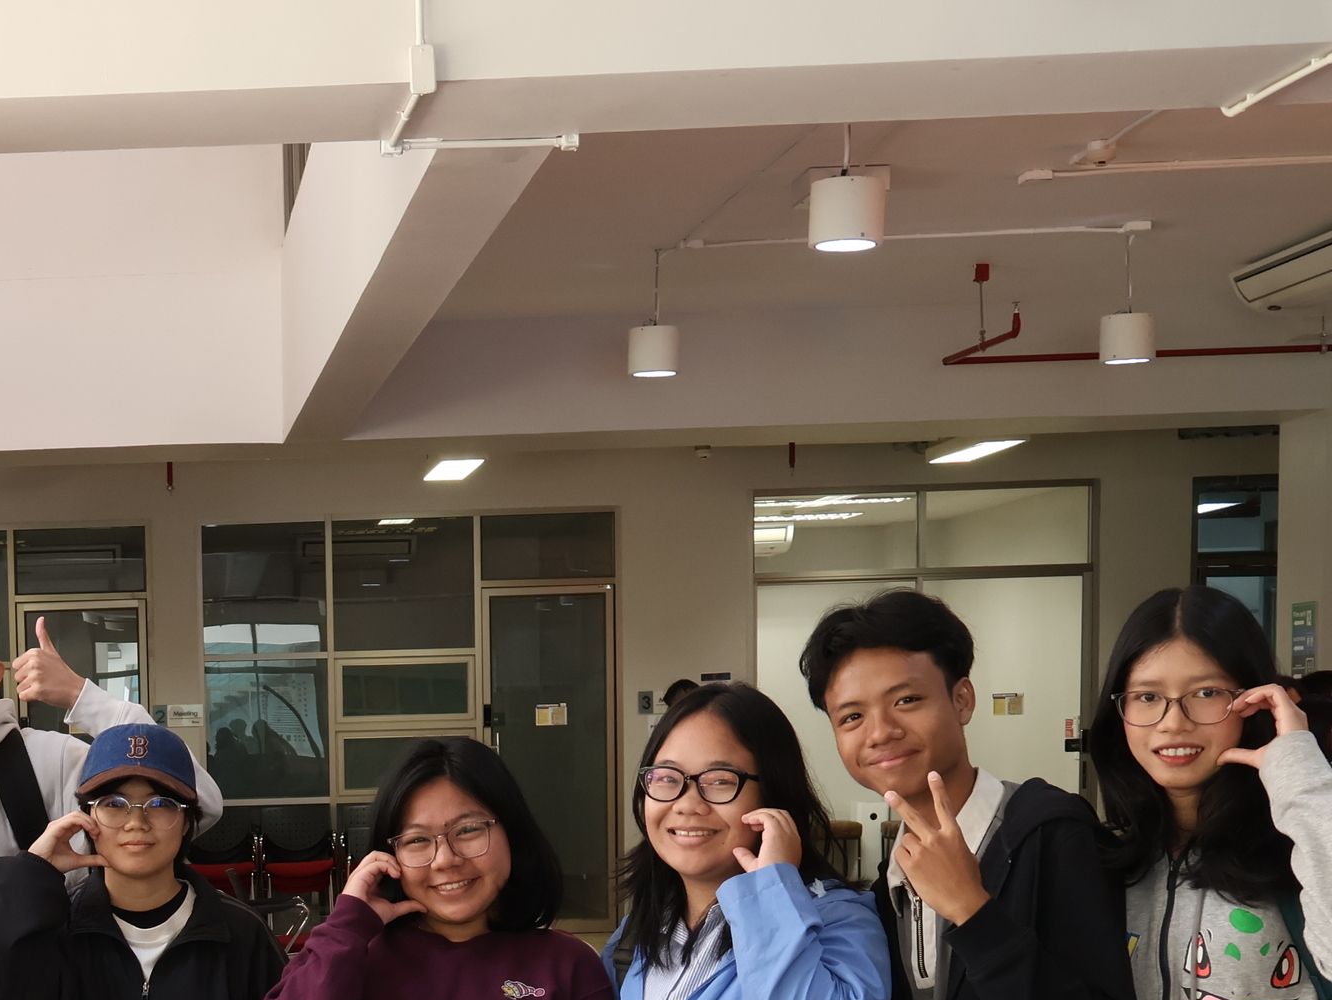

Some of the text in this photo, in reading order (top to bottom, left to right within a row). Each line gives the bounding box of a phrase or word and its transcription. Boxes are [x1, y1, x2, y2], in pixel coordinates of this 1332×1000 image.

[642, 695, 651, 710] 3
[154, 710, 166, 724] 2
[126, 735, 149, 759] B
